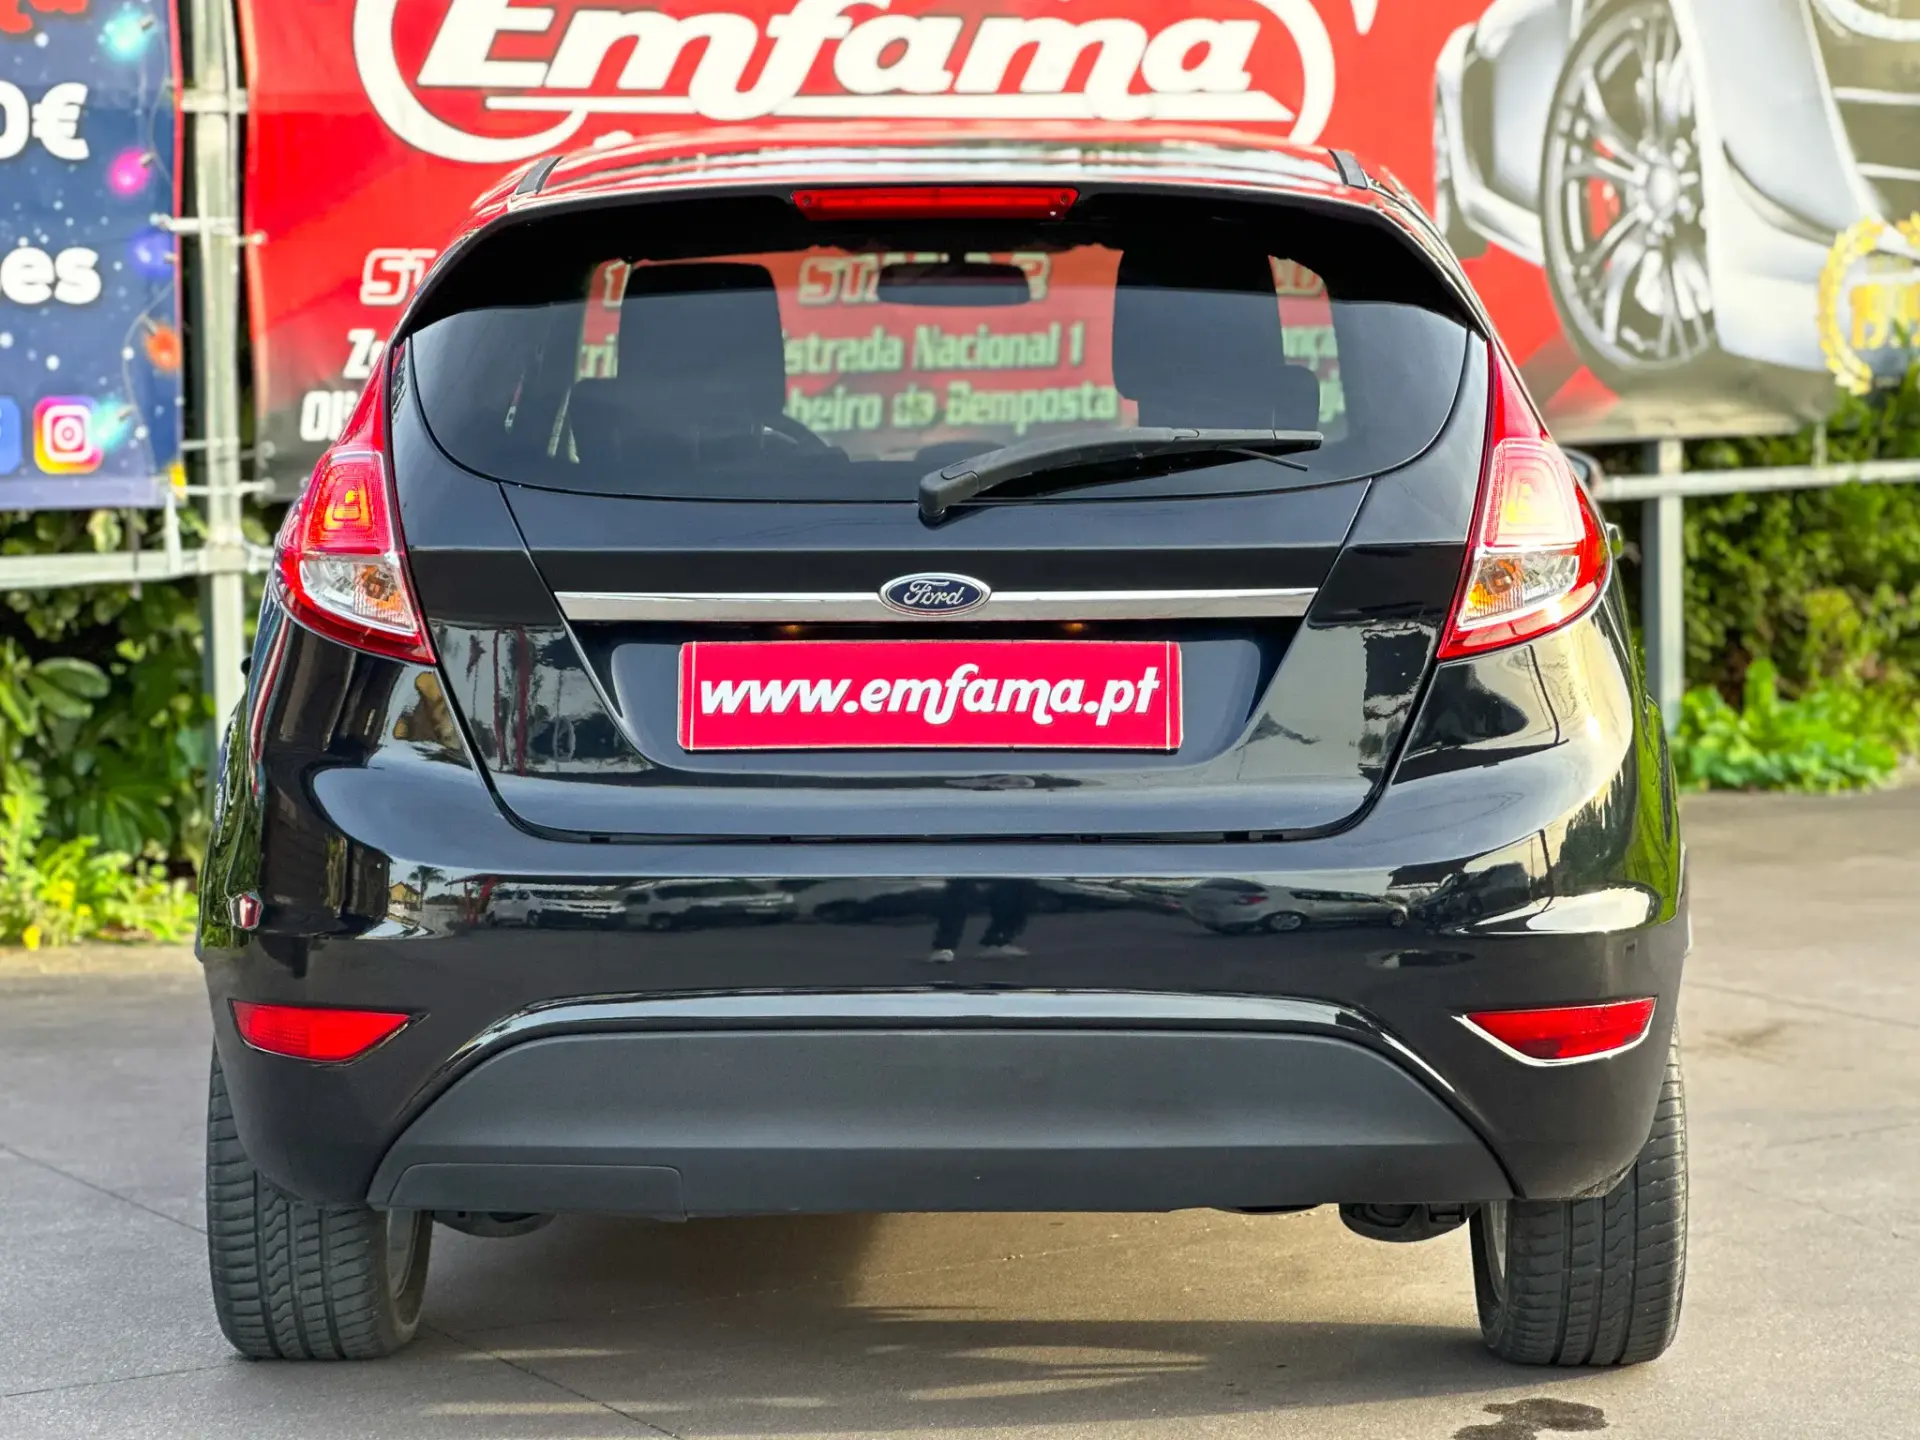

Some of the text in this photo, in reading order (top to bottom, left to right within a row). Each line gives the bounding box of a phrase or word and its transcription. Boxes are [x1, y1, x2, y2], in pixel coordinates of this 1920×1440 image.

[416, 0, 1262, 121] Emfama
[782, 319, 1084, 375] strada Nacional 1
[782, 385, 883, 432] heiro
[945, 379, 1120, 436] Bemposta
[903, 579, 966, 606] Ford
[700, 663, 1160, 727] www.emfama.pt
